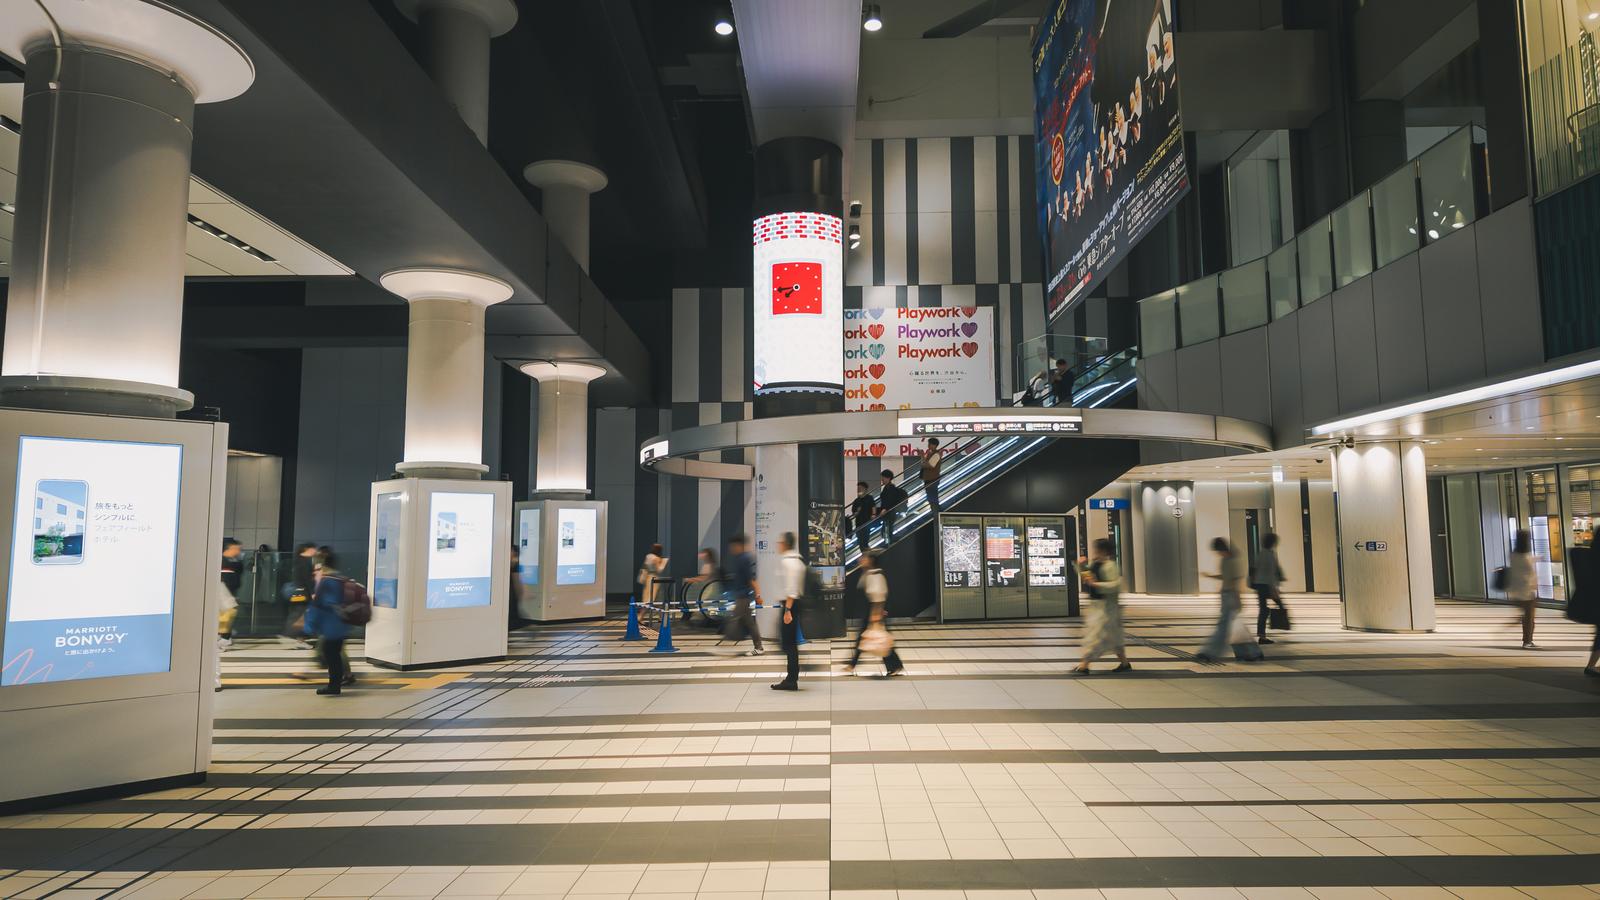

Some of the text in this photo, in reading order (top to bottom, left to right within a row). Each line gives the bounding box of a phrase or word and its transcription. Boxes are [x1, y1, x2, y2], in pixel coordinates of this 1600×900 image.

[844, 309, 868, 320] ork
[898, 306, 961, 323] Playwork
[844, 324, 868, 340] ork
[898, 322, 961, 342] Playwork
[844, 344, 869, 360] ork
[898, 341, 962, 362] Playwork
[845, 384, 869, 399] ork
[95, 502, 133, 510] 旅をもっと
[65, 625, 118, 635] MARRIOTT
